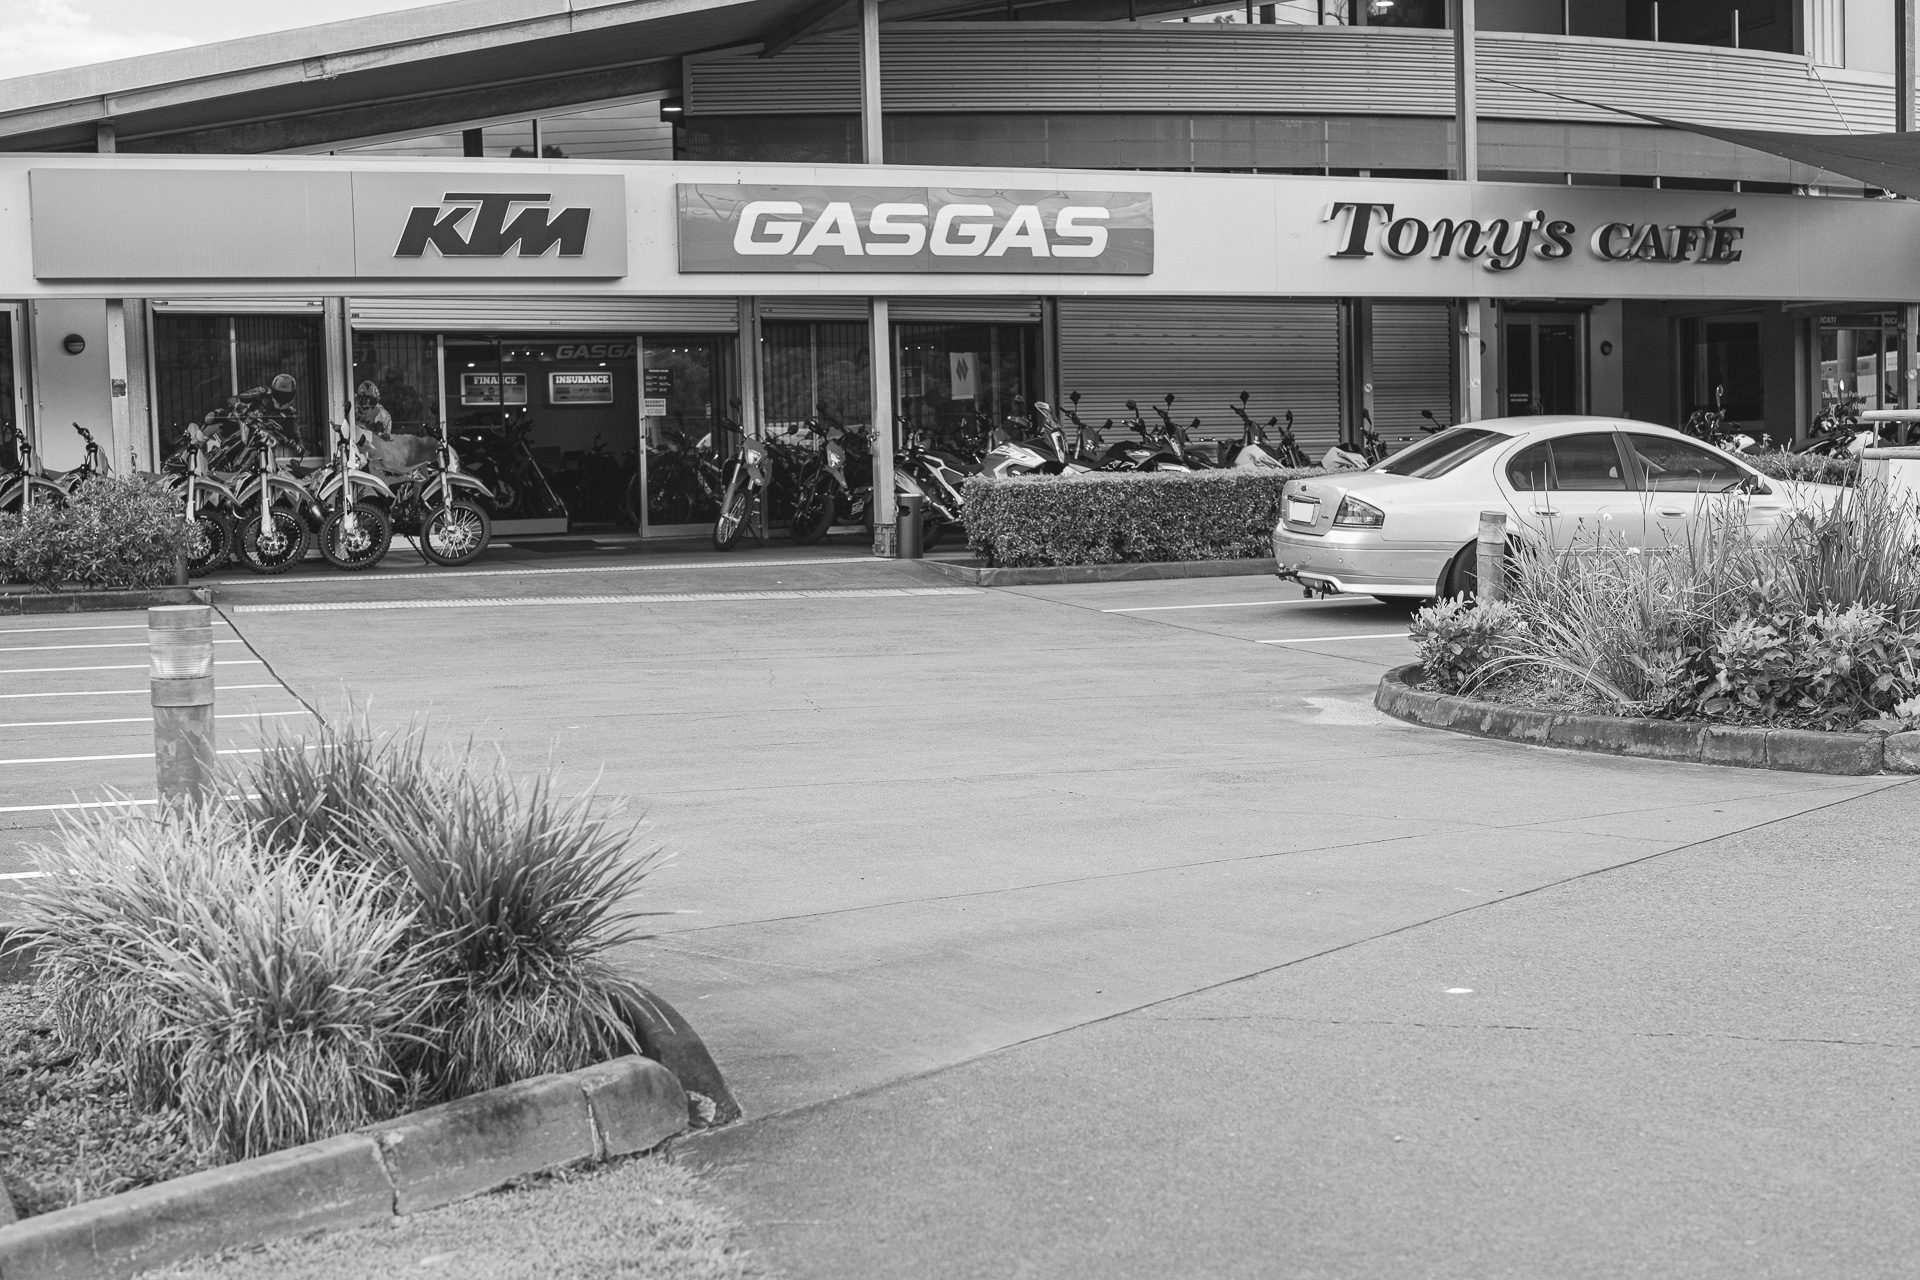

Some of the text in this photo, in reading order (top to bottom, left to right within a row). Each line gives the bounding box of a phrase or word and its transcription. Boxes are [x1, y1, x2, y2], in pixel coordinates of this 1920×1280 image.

[393, 190, 591, 259] KTM
[733, 200, 1110, 259] GASGAS
[1322, 201, 1745, 272] Tony's CAFÉ
[473, 376, 518, 385] FINACE
[555, 375, 609, 384] INSURANCE
